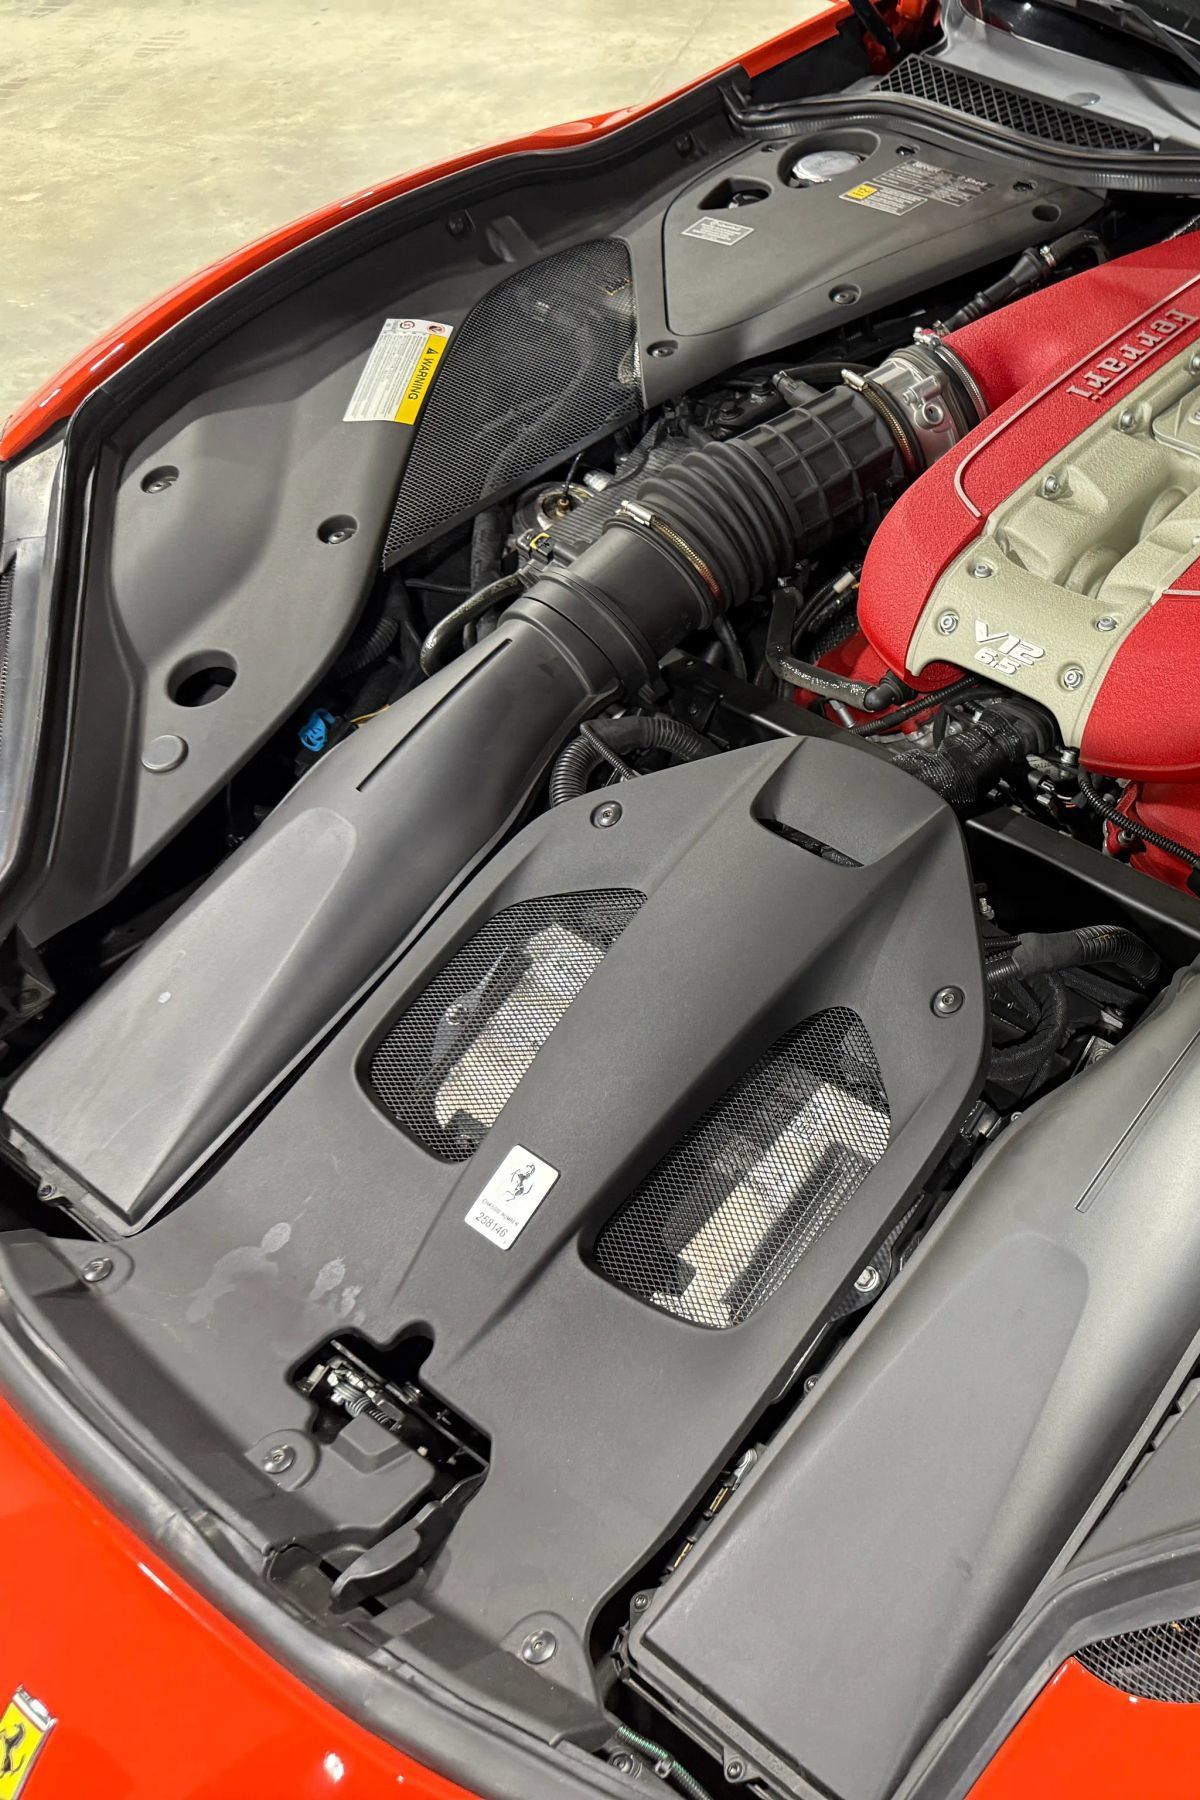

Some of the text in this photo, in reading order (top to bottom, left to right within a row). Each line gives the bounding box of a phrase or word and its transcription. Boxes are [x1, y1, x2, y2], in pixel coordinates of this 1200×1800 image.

[1066, 308, 1200, 401] Ferrari
[408, 358, 434, 400] WARNING
[974, 646, 1021, 675] 6.5
[975, 618, 1045, 666] V12
[475, 1212, 508, 1237] 258146
